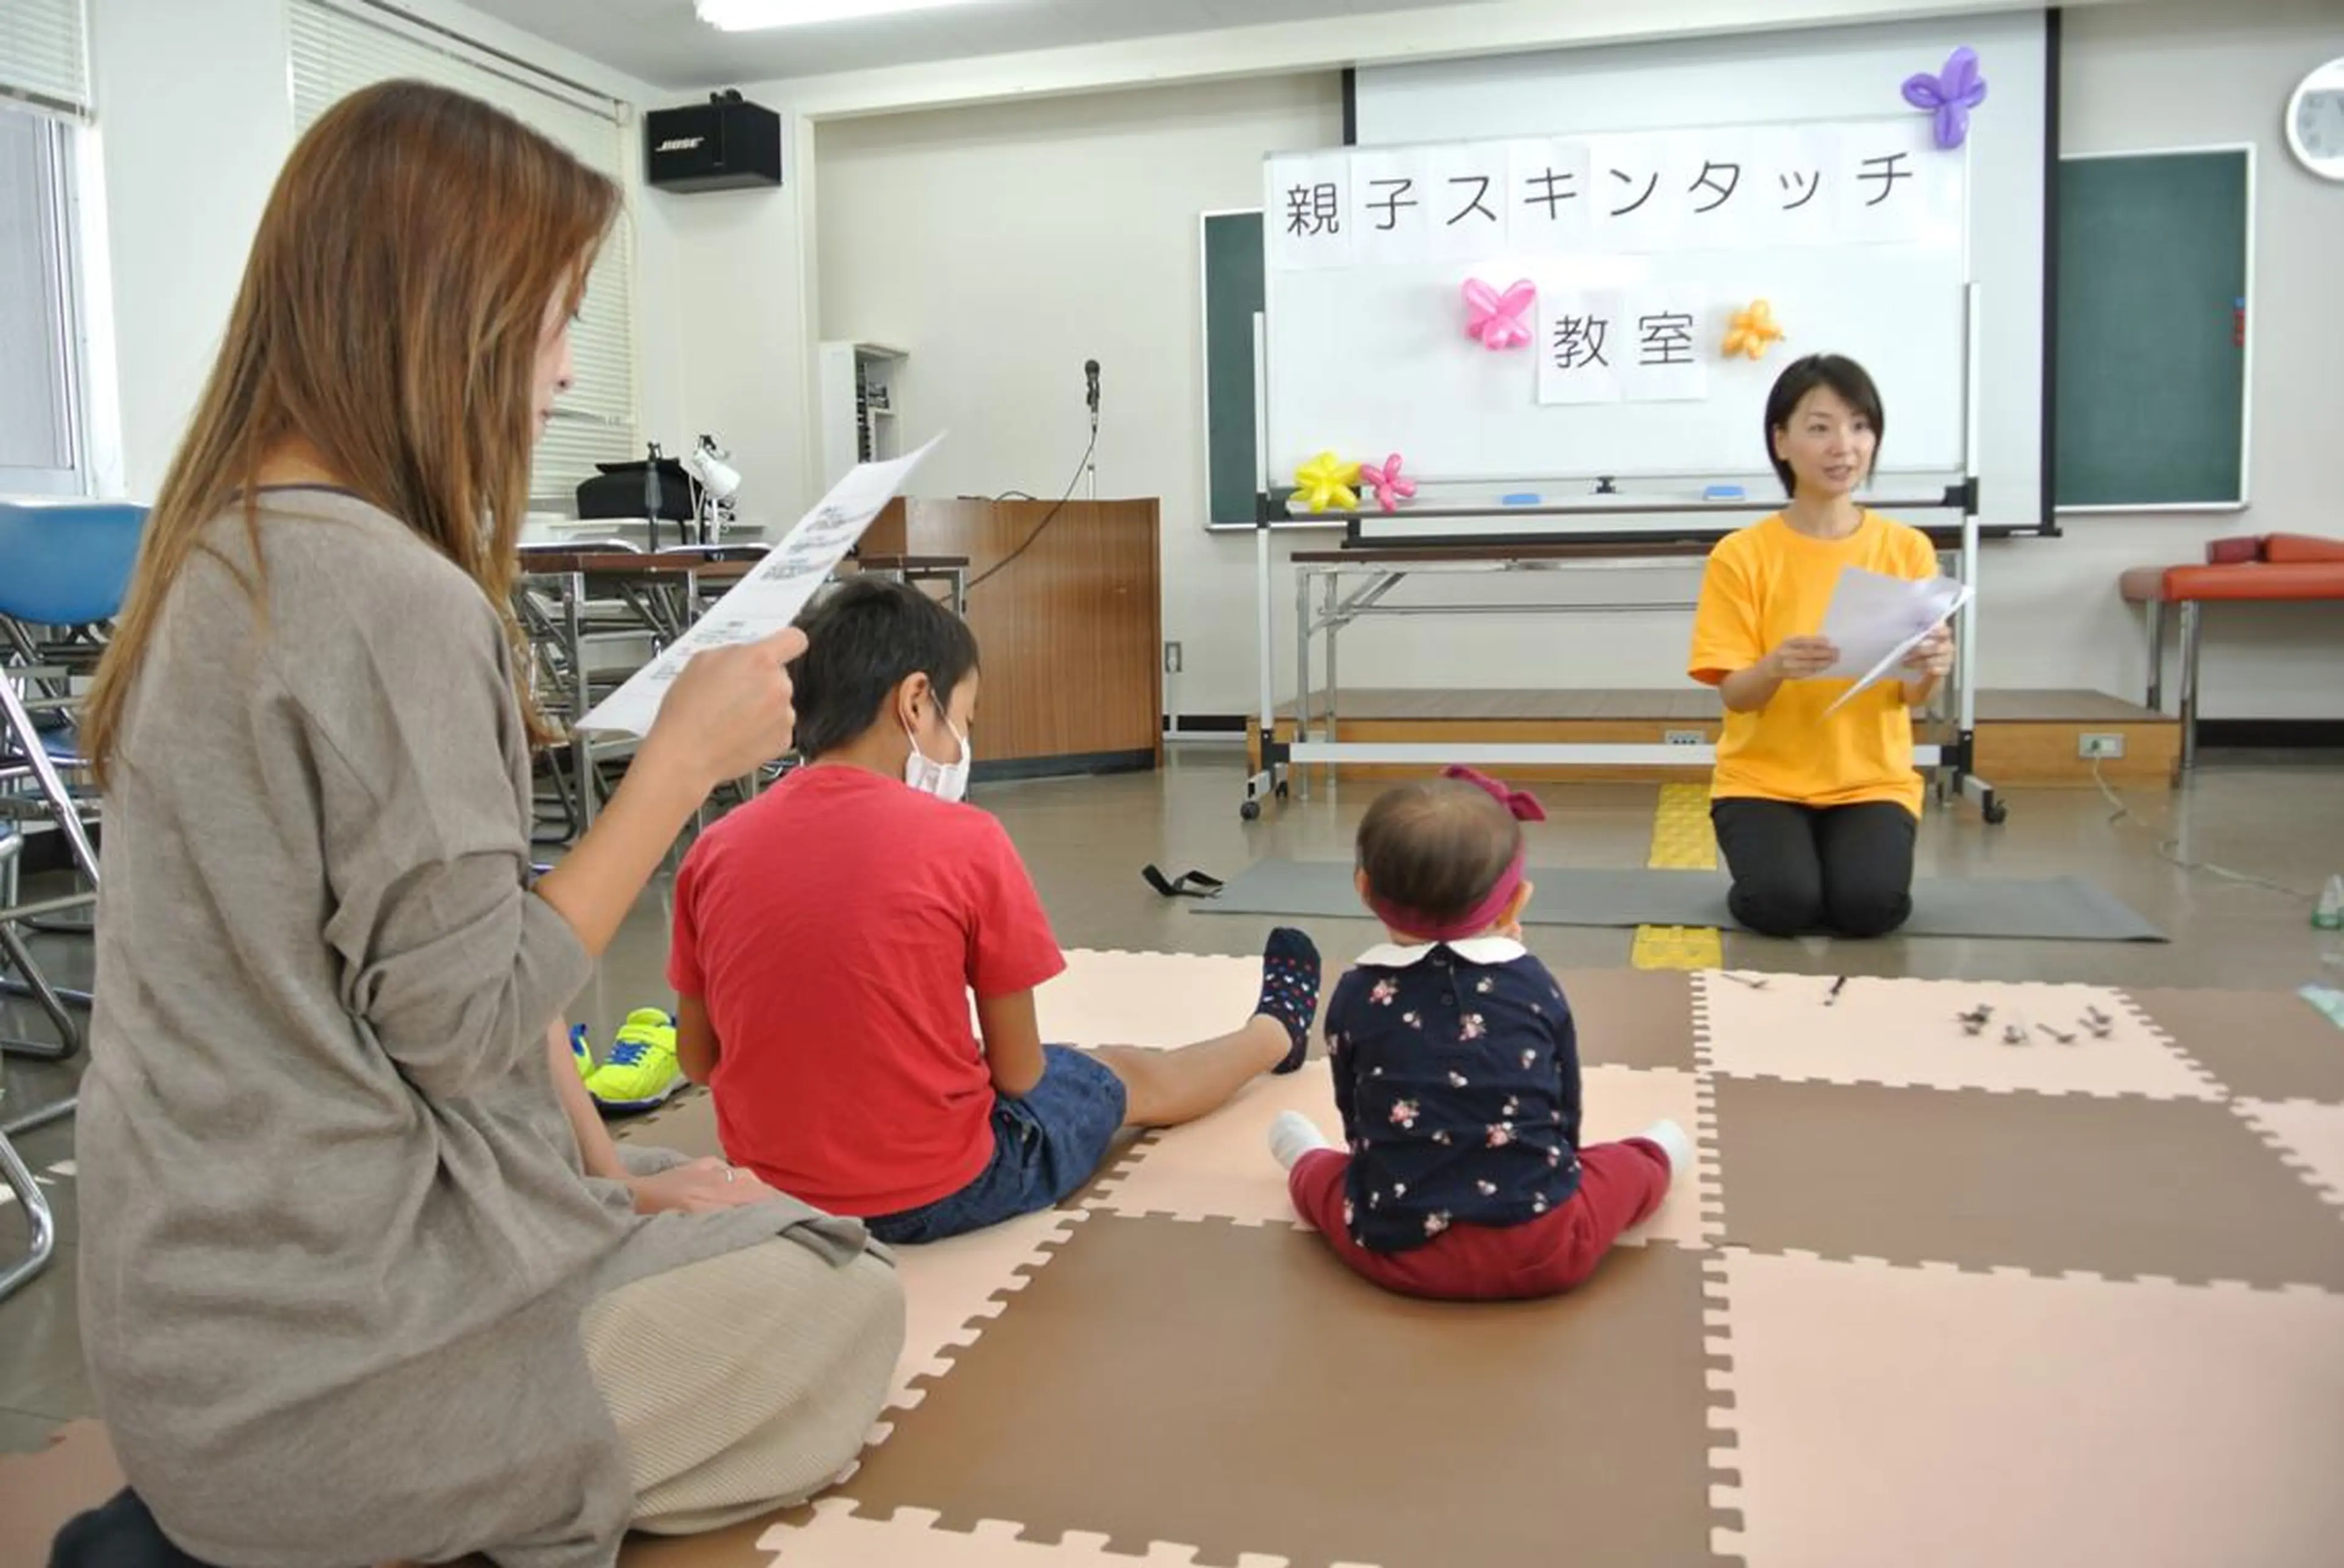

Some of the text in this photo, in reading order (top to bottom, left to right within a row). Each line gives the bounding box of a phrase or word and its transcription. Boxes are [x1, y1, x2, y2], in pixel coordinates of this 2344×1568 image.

[1286, 151, 1914, 238] 親子スキンタッチ
[1552, 309, 1695, 370] 教室
